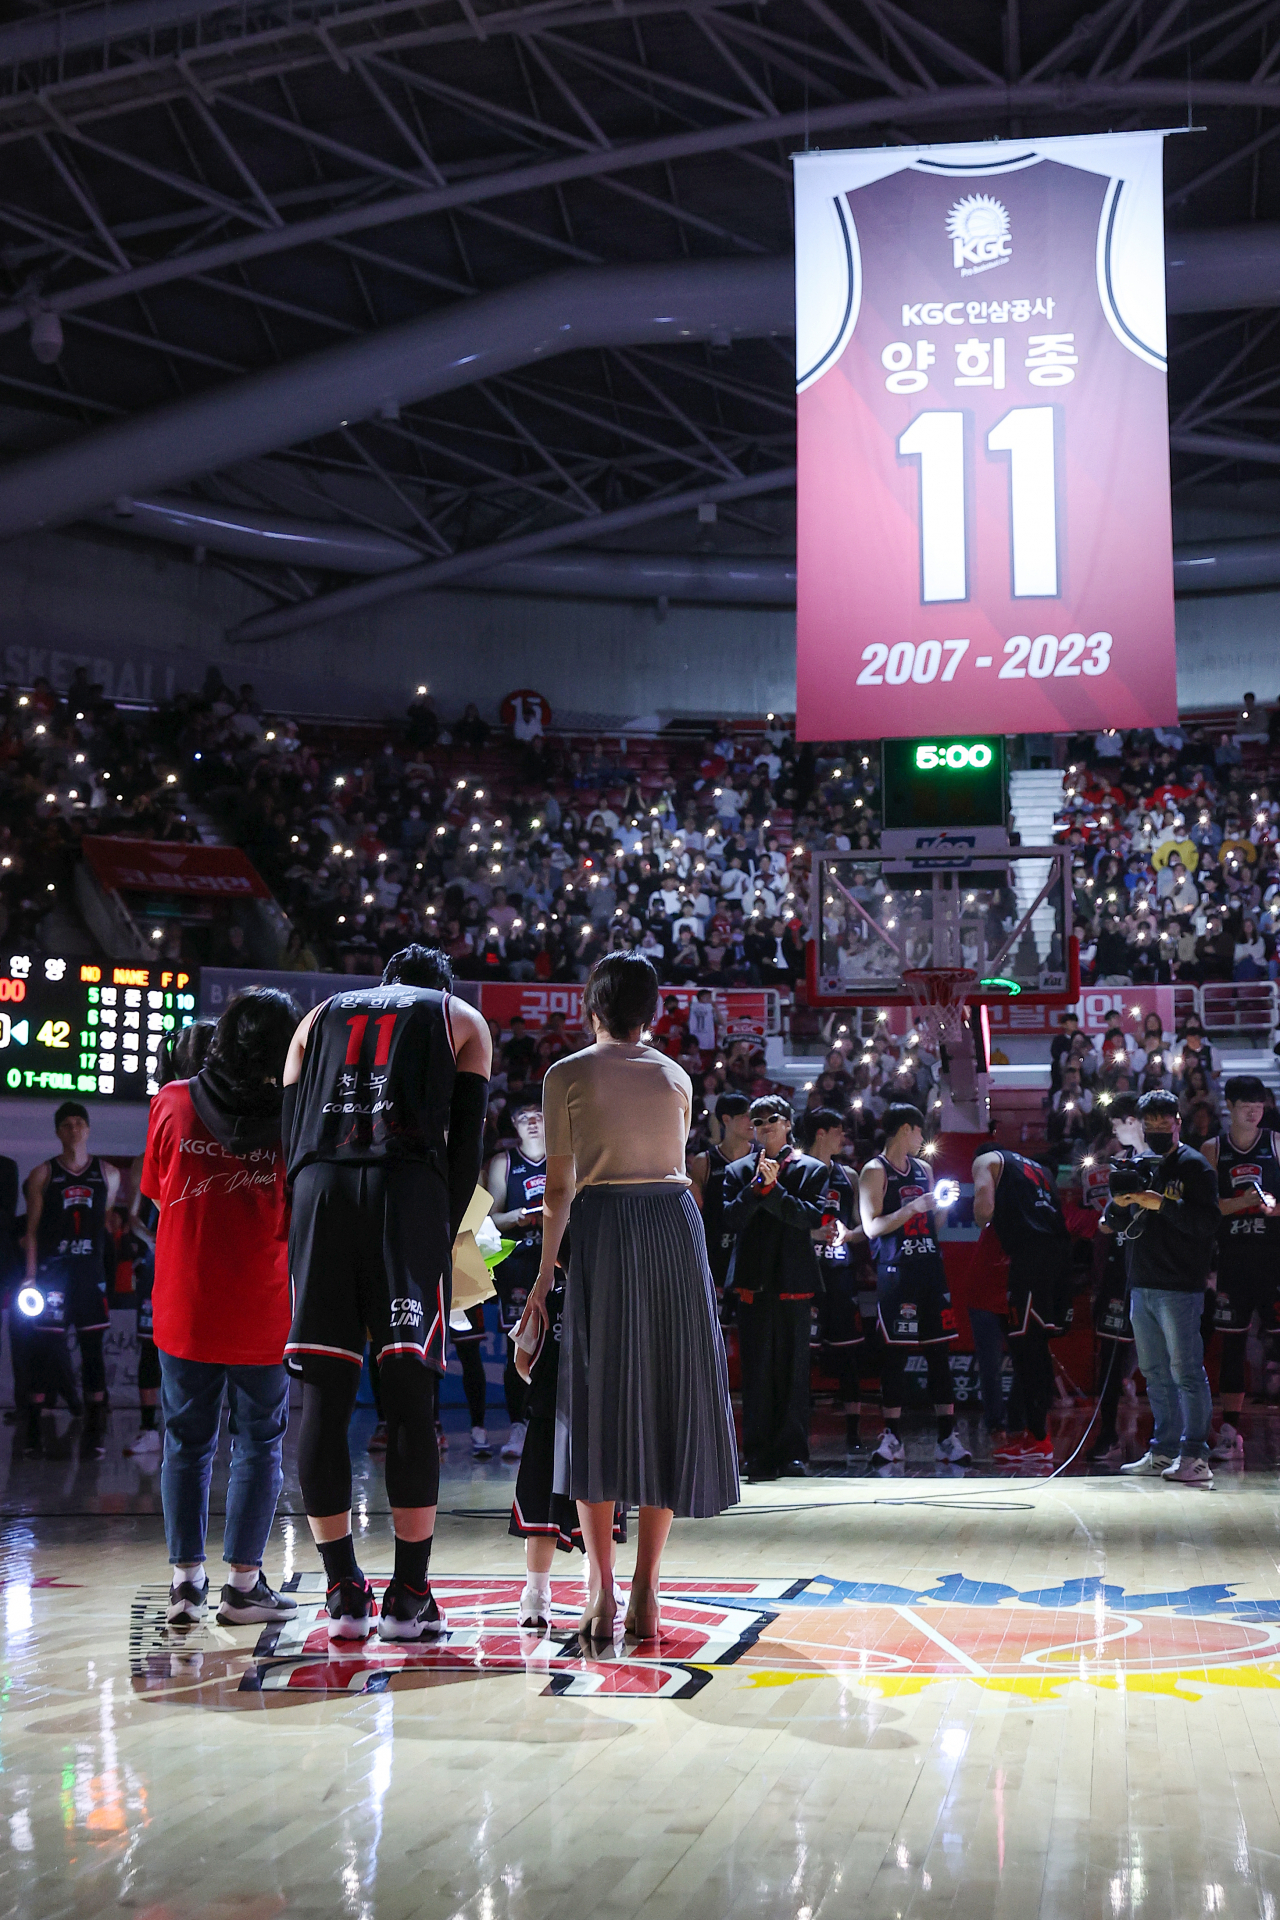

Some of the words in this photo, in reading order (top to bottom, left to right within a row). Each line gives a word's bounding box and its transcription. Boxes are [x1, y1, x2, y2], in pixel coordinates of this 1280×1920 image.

[953, 233, 1013, 268] KGC
[901, 296, 1055, 326] KGC인삼공사
[898, 405, 1058, 603] 11
[915, 743, 992, 769] 5:00
[80, 965, 101, 983] NO
[113, 968, 149, 987] NAME
[161, 971, 173, 988] F
[177, 973, 190, 989] P
[87, 986, 100, 1004] 5
[165, 993, 173, 1009] 1
[176, 994, 195, 1010] 10
[86, 1009, 99, 1026] 6
[36, 1020, 71, 1048] 42
[80, 1031, 97, 1048] 11
[346, 1014, 397, 1066] 11
[79, 1053, 98, 1069] 17
[23, 1070, 76, 1090] T-FOUL
